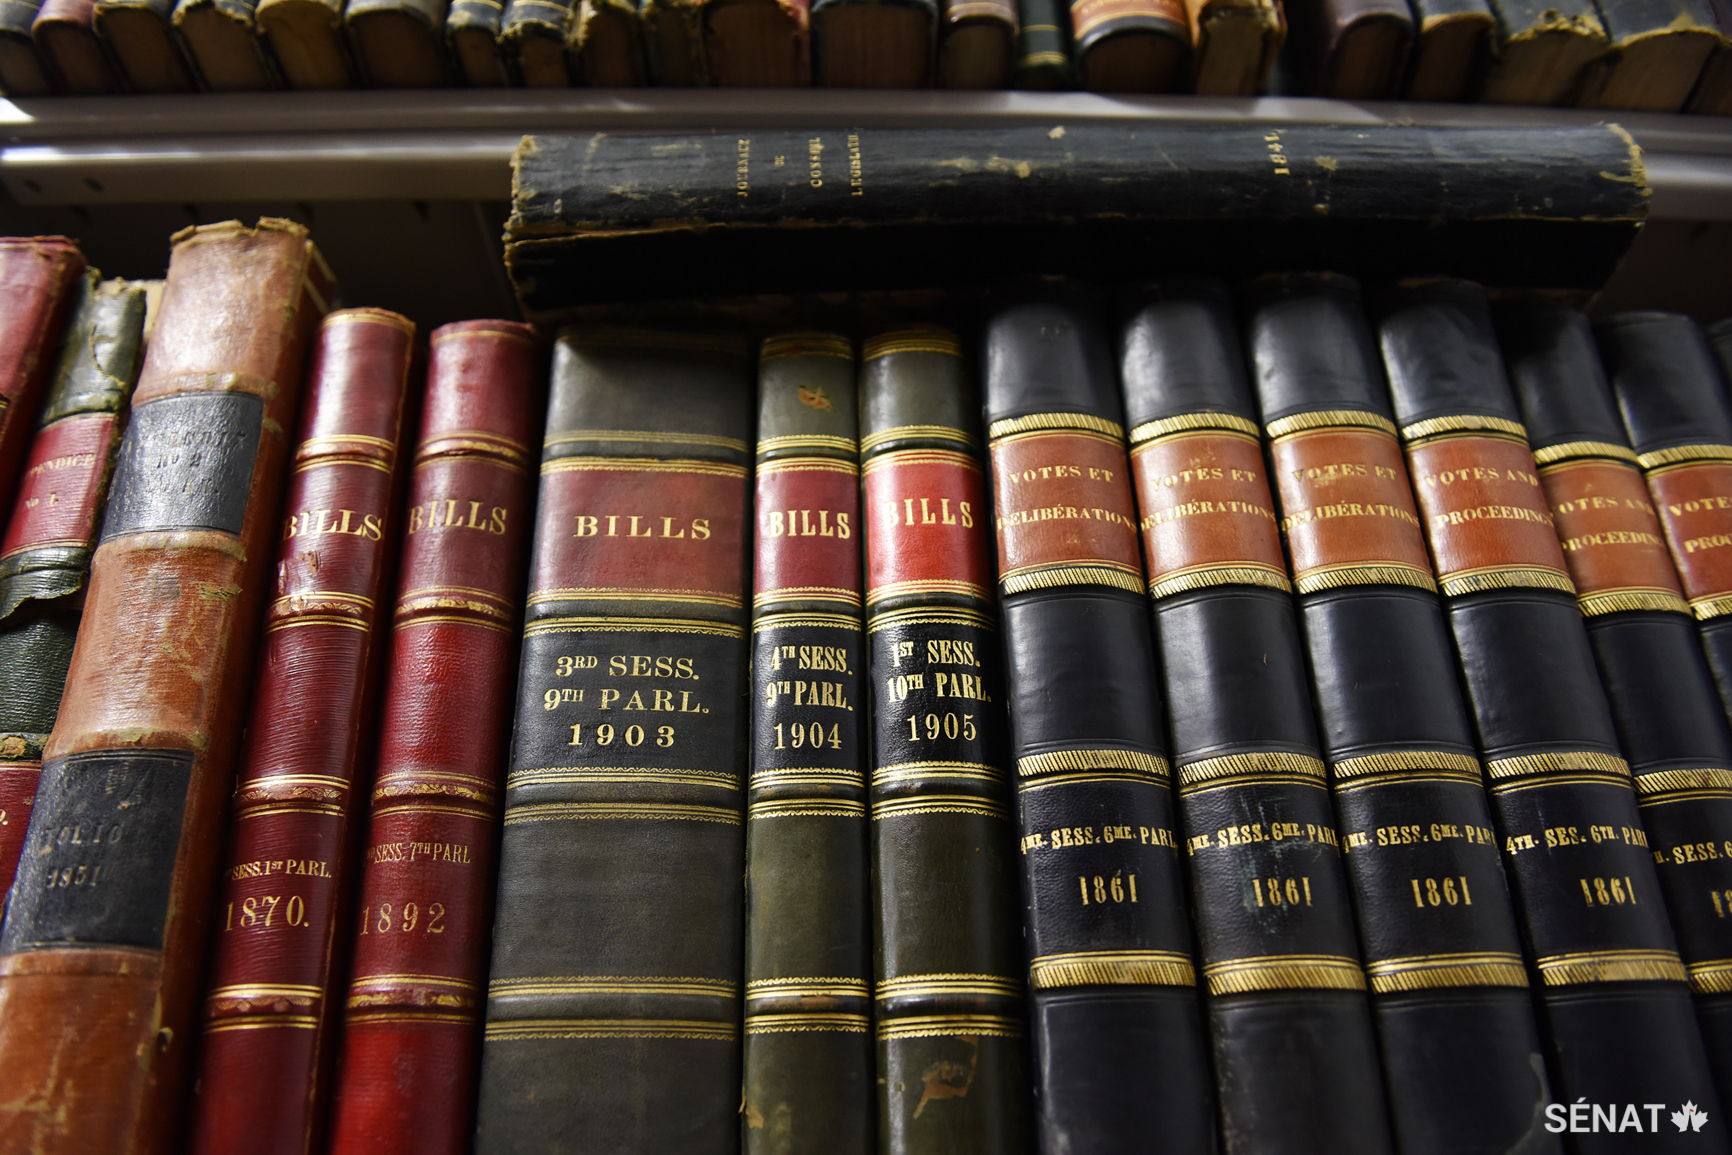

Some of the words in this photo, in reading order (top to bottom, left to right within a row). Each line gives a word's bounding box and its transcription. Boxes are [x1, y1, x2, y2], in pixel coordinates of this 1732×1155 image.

[1008, 465, 1082, 485] VOTES
[1088, 467, 1114, 483] ET
[1150, 467, 1224, 491] VOTES
[1231, 468, 1256, 483] ET
[1292, 463, 1368, 483] VOTES
[1374, 465, 1397, 482] ET
[1424, 466, 1500, 488] VOTES
[1506, 469, 1539, 487] AND
[408, 498, 507, 535] BILLS
[883, 498, 973, 528] BILLS
[1557, 496, 1619, 514] OTES
[1668, 496, 1732, 517] VOTE
[283, 509, 382, 541] BILLS
[572, 515, 711, 540] BILLS
[768, 509, 850, 539] BILLS
[555, 656, 598, 677] 3RD
[608, 655, 699, 680] SESS.
[770, 645, 796, 671] 4TH
[798, 645, 853, 675] SESS.
[891, 641, 914, 668] 1ST
[927, 639, 981, 668] SESS.
[543, 688, 585, 711] 9TH
[598, 688, 710, 714] PARL.
[766, 681, 791, 708] 9TH
[793, 680, 853, 711] PARL.
[887, 671, 924, 703] 10TH
[935, 672, 992, 703] PARL.
[568, 723, 675, 748] 1903
[774, 721, 842, 750] 1904
[906, 712, 977, 742] 1905
[409, 841, 431, 862] 7TH
[432, 842, 471, 864] PARL
[284, 858, 332, 879] PARL.
[1079, 873, 1138, 906] 1861
[1252, 876, 1312, 908] 1861
[1410, 875, 1473, 908] 1861
[1579, 875, 1638, 908] 1861
[223, 895, 309, 932] 1870.
[360, 902, 446, 936] 1892
